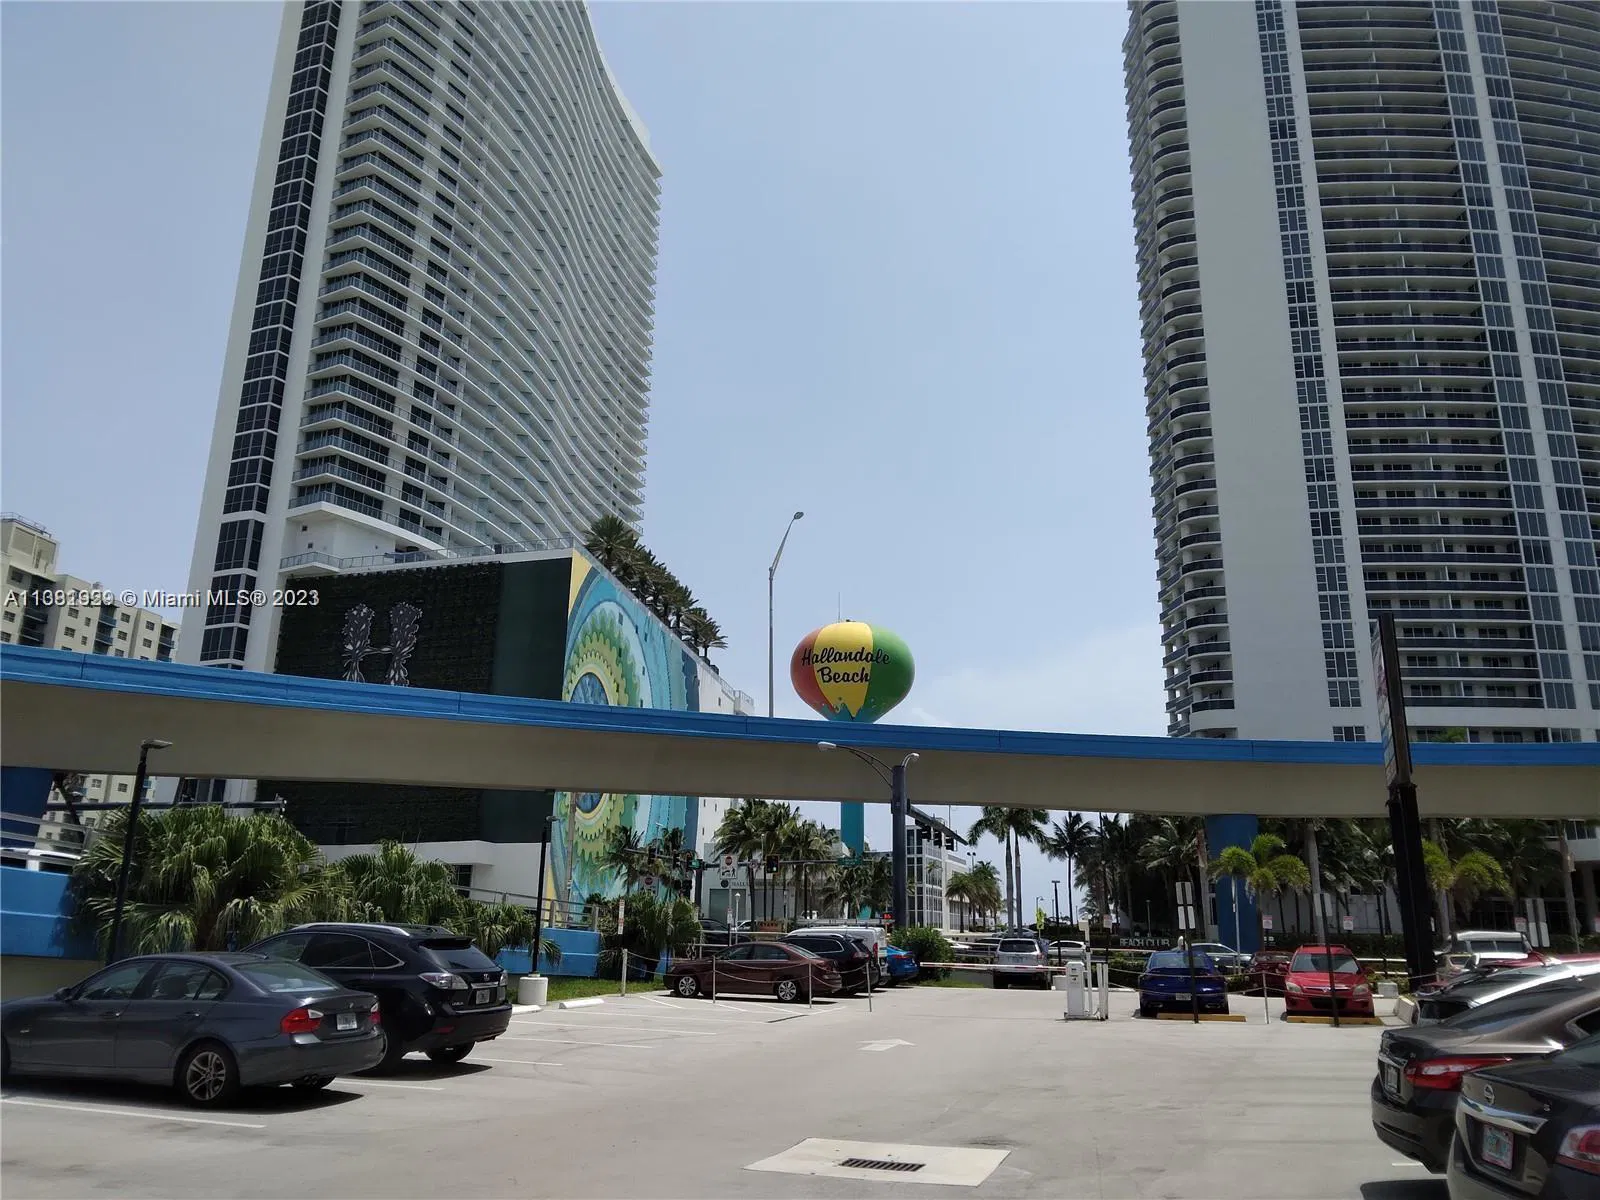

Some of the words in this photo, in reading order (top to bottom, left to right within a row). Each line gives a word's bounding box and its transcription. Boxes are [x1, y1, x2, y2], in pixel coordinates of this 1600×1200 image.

[801, 646, 891, 666] Hallandale
[817, 666, 871, 684] Beach
[1119, 938, 1144, 947] BEACH
